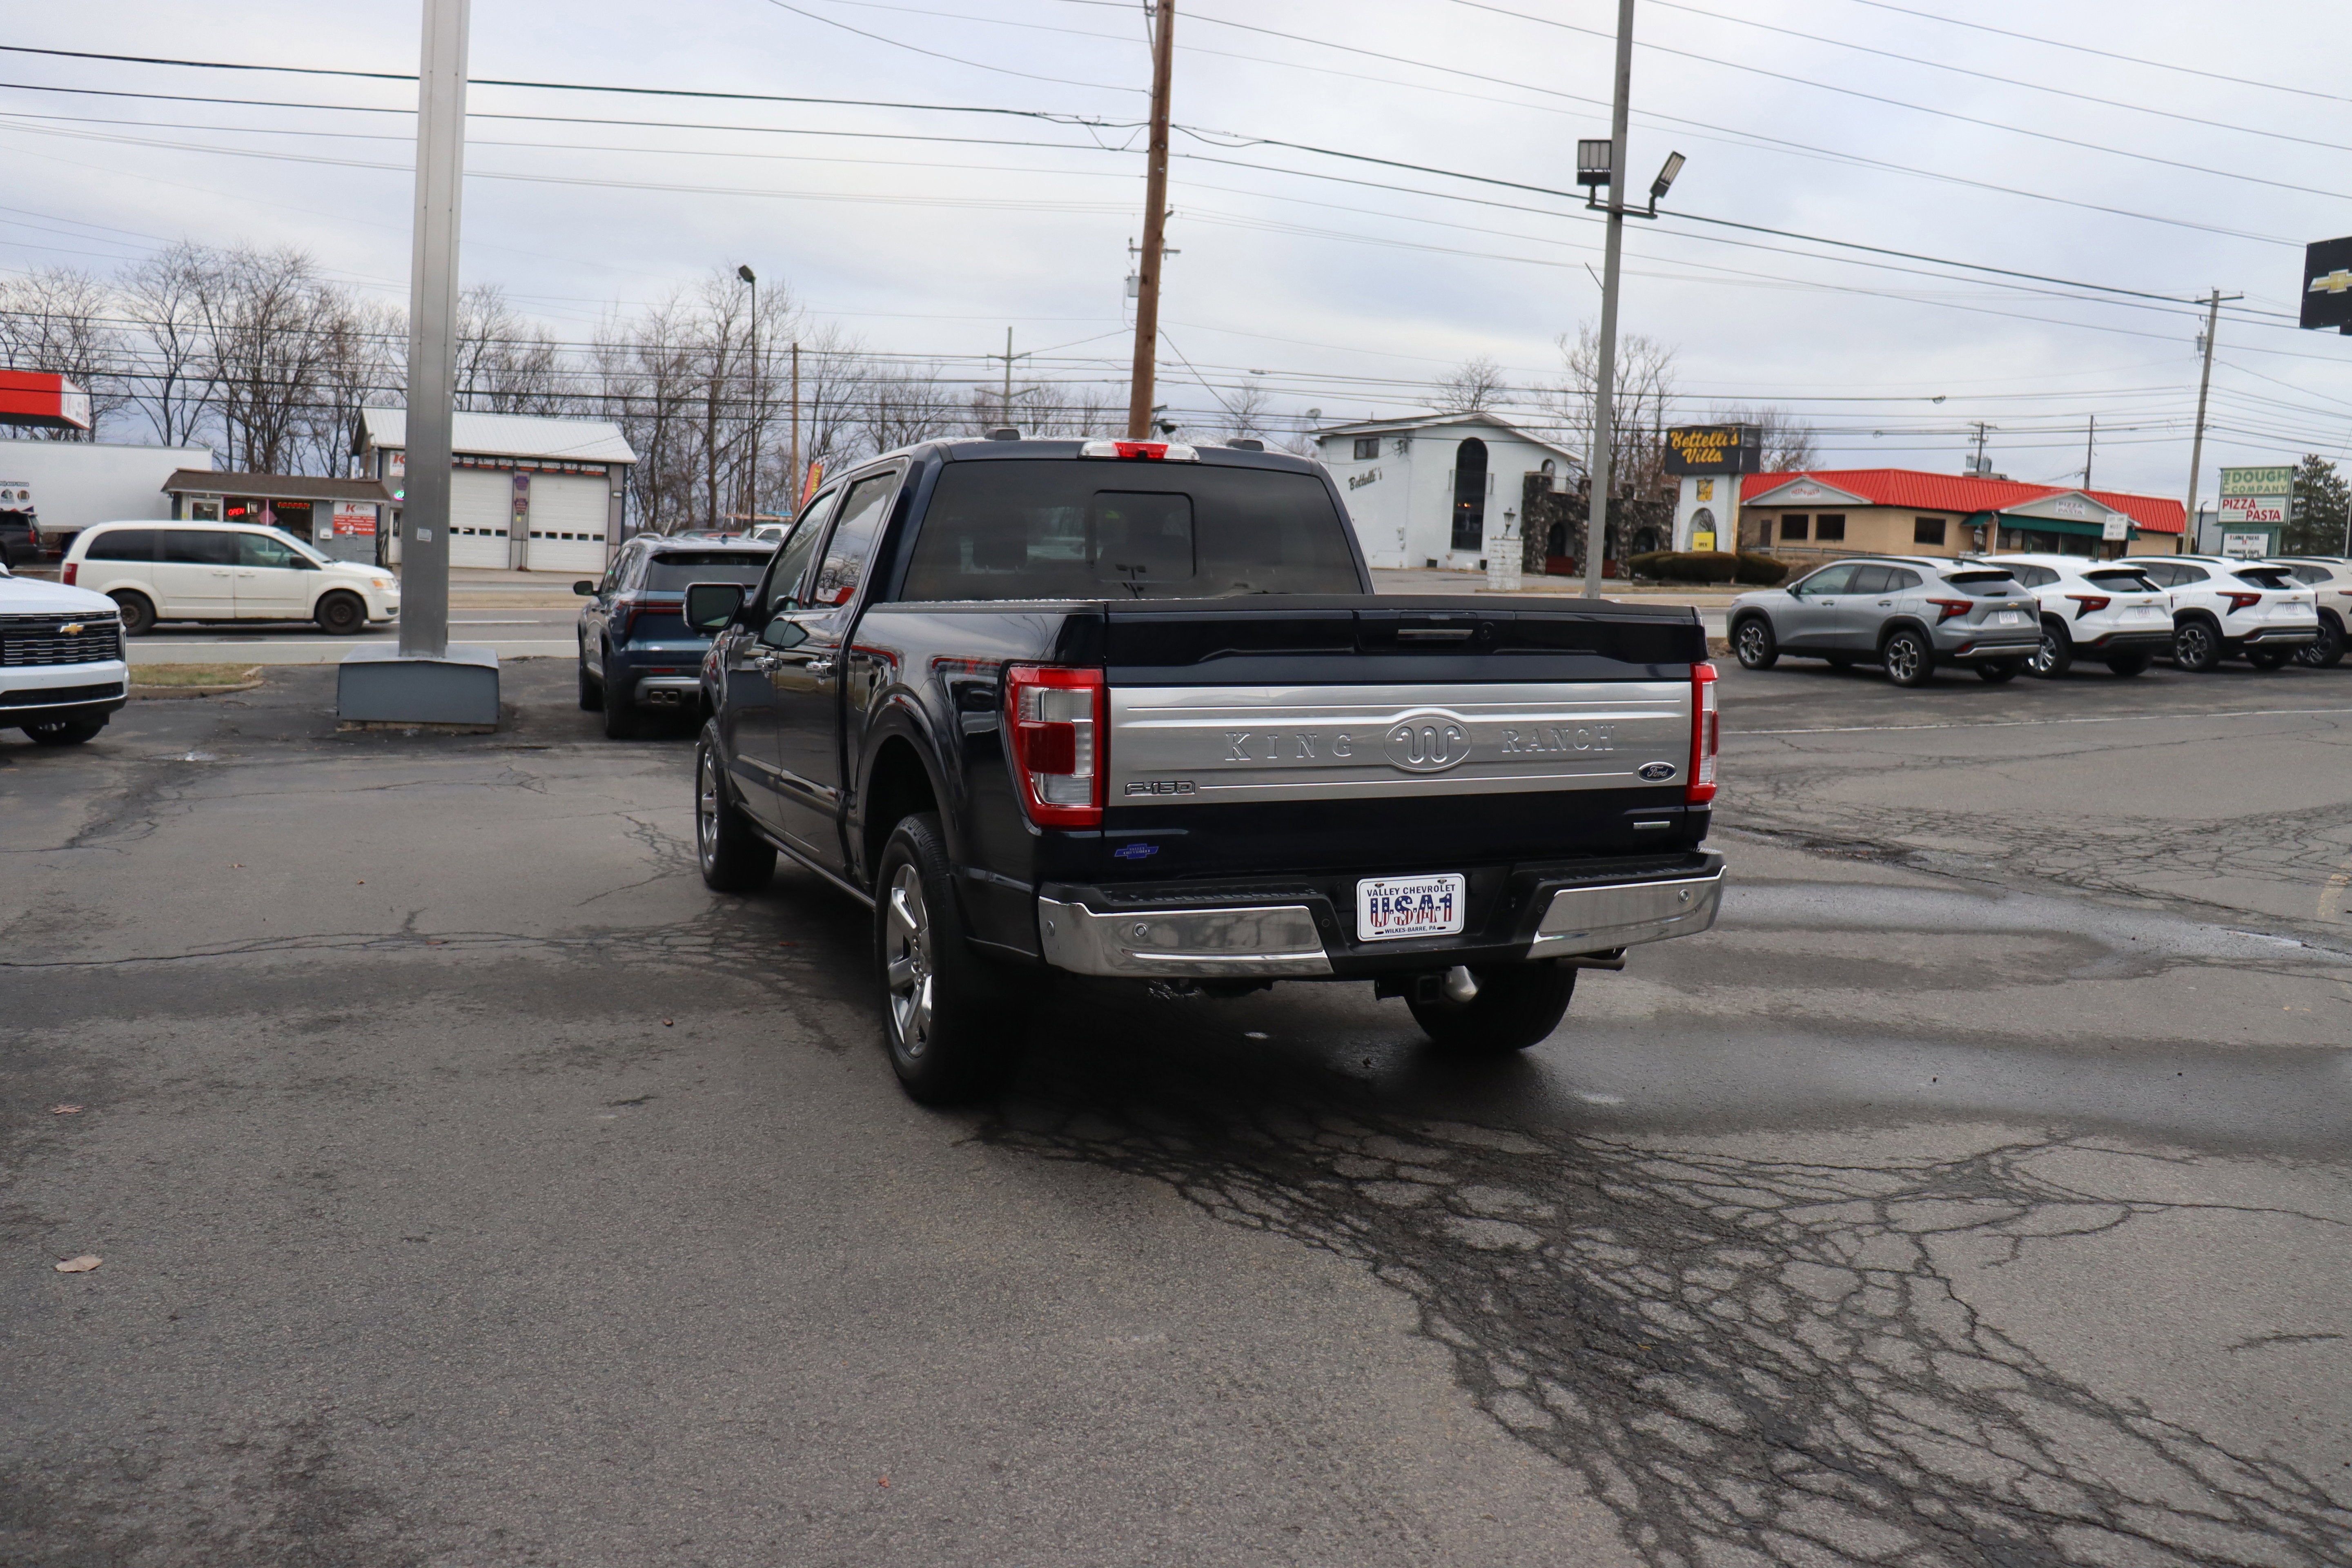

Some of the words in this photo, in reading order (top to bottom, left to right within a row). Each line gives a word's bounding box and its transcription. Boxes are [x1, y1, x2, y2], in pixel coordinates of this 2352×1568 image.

[1682, 448, 1723, 464] Villa
[2233, 470, 2289, 483] DOUGH
[2232, 485, 2287, 494] COMPANY
[2223, 498, 2256, 510] PIZZA
[228, 508, 245, 516] OPEN
[2246, 510, 2281, 521] PASTA
[1225, 732, 1352, 761] KING
[1501, 724, 1615, 753] RANCH
[1647, 766, 1669, 777] Ford
[1125, 780, 1195, 796] F-150
[1367, 887, 1400, 897] VALLEY
[1403, 884, 1456, 895] CHEVROLET
